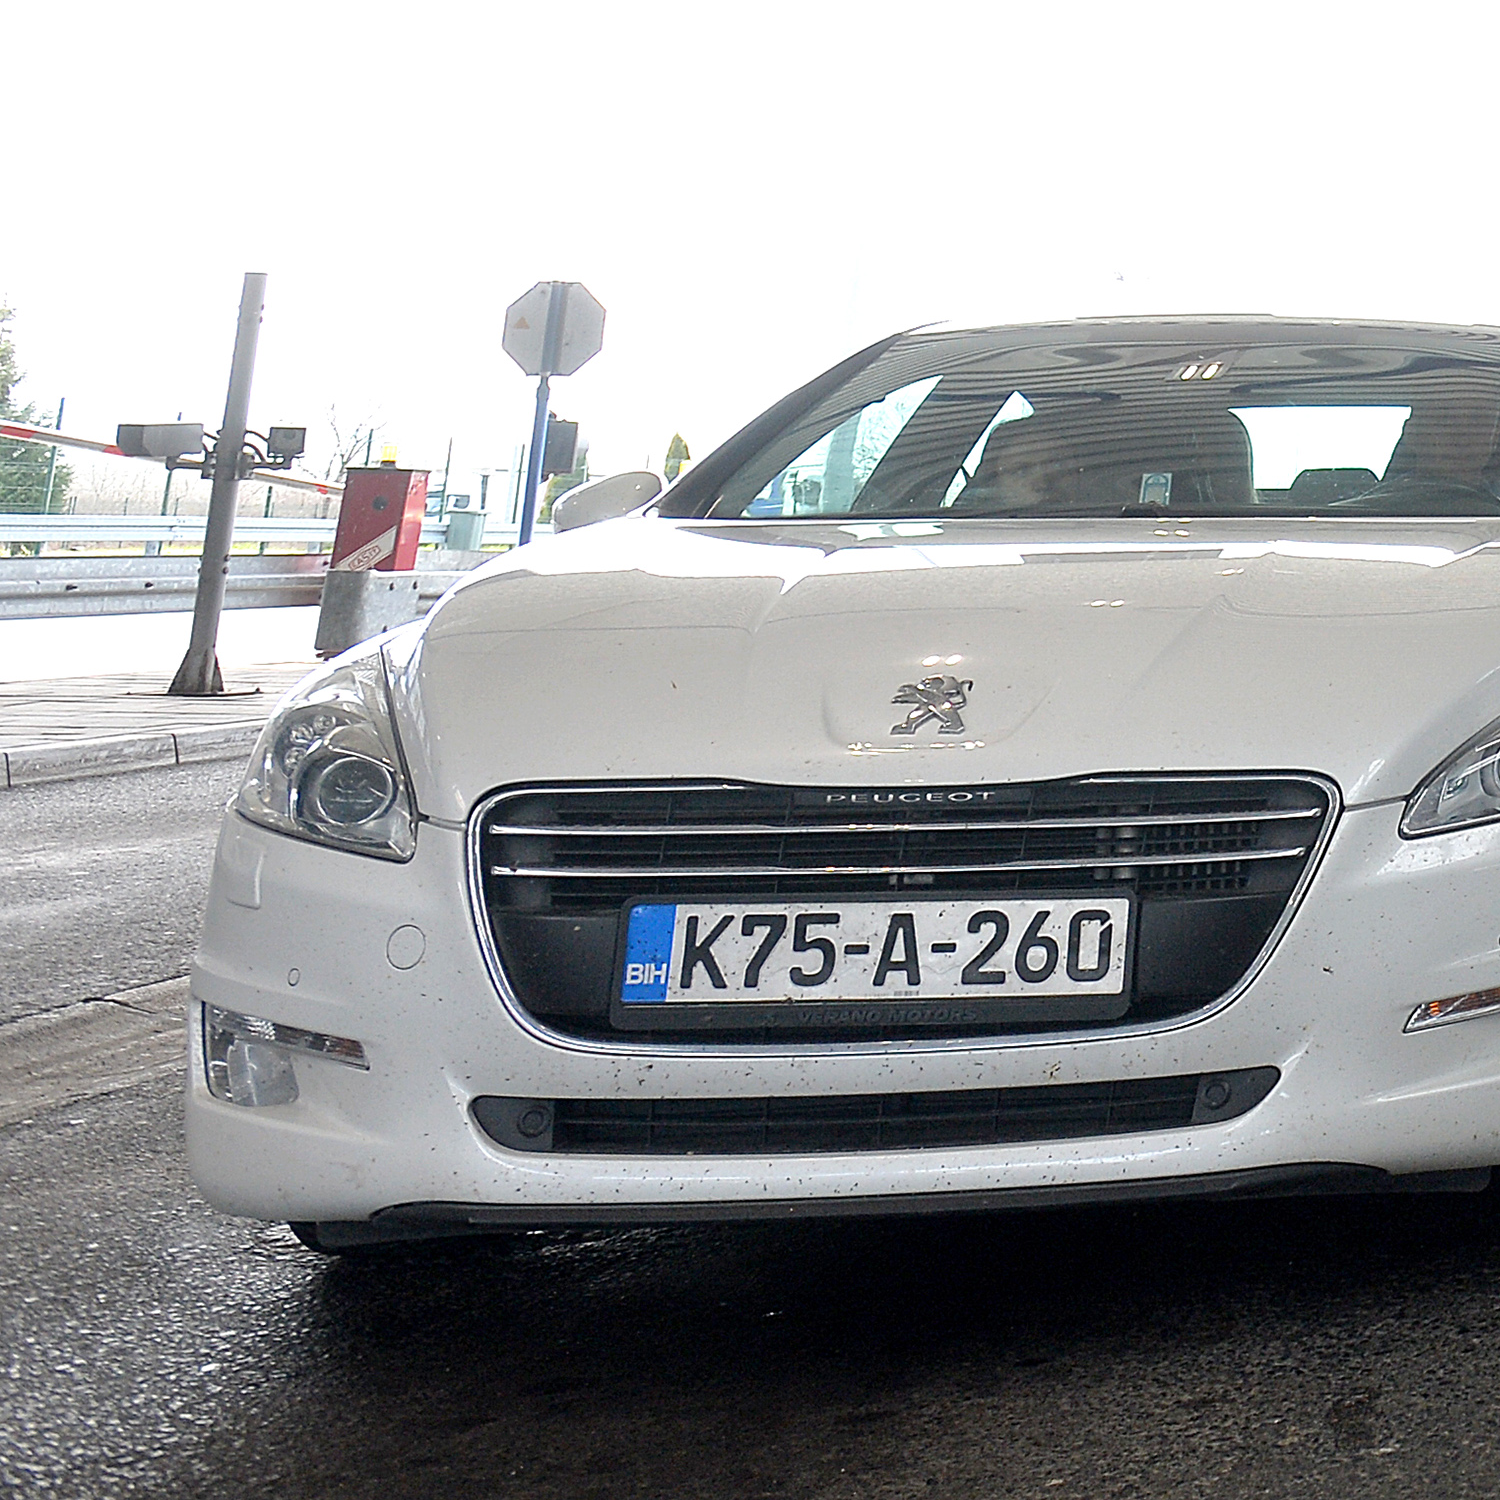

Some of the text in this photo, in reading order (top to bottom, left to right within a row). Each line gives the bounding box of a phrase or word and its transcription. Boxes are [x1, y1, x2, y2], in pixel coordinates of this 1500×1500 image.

[826, 792, 996, 803] PEUGEOT
[679, 910, 1112, 989] K75-A-260
[624, 963, 667, 985] BIH
[888, 1008, 978, 1023] MOTORS
